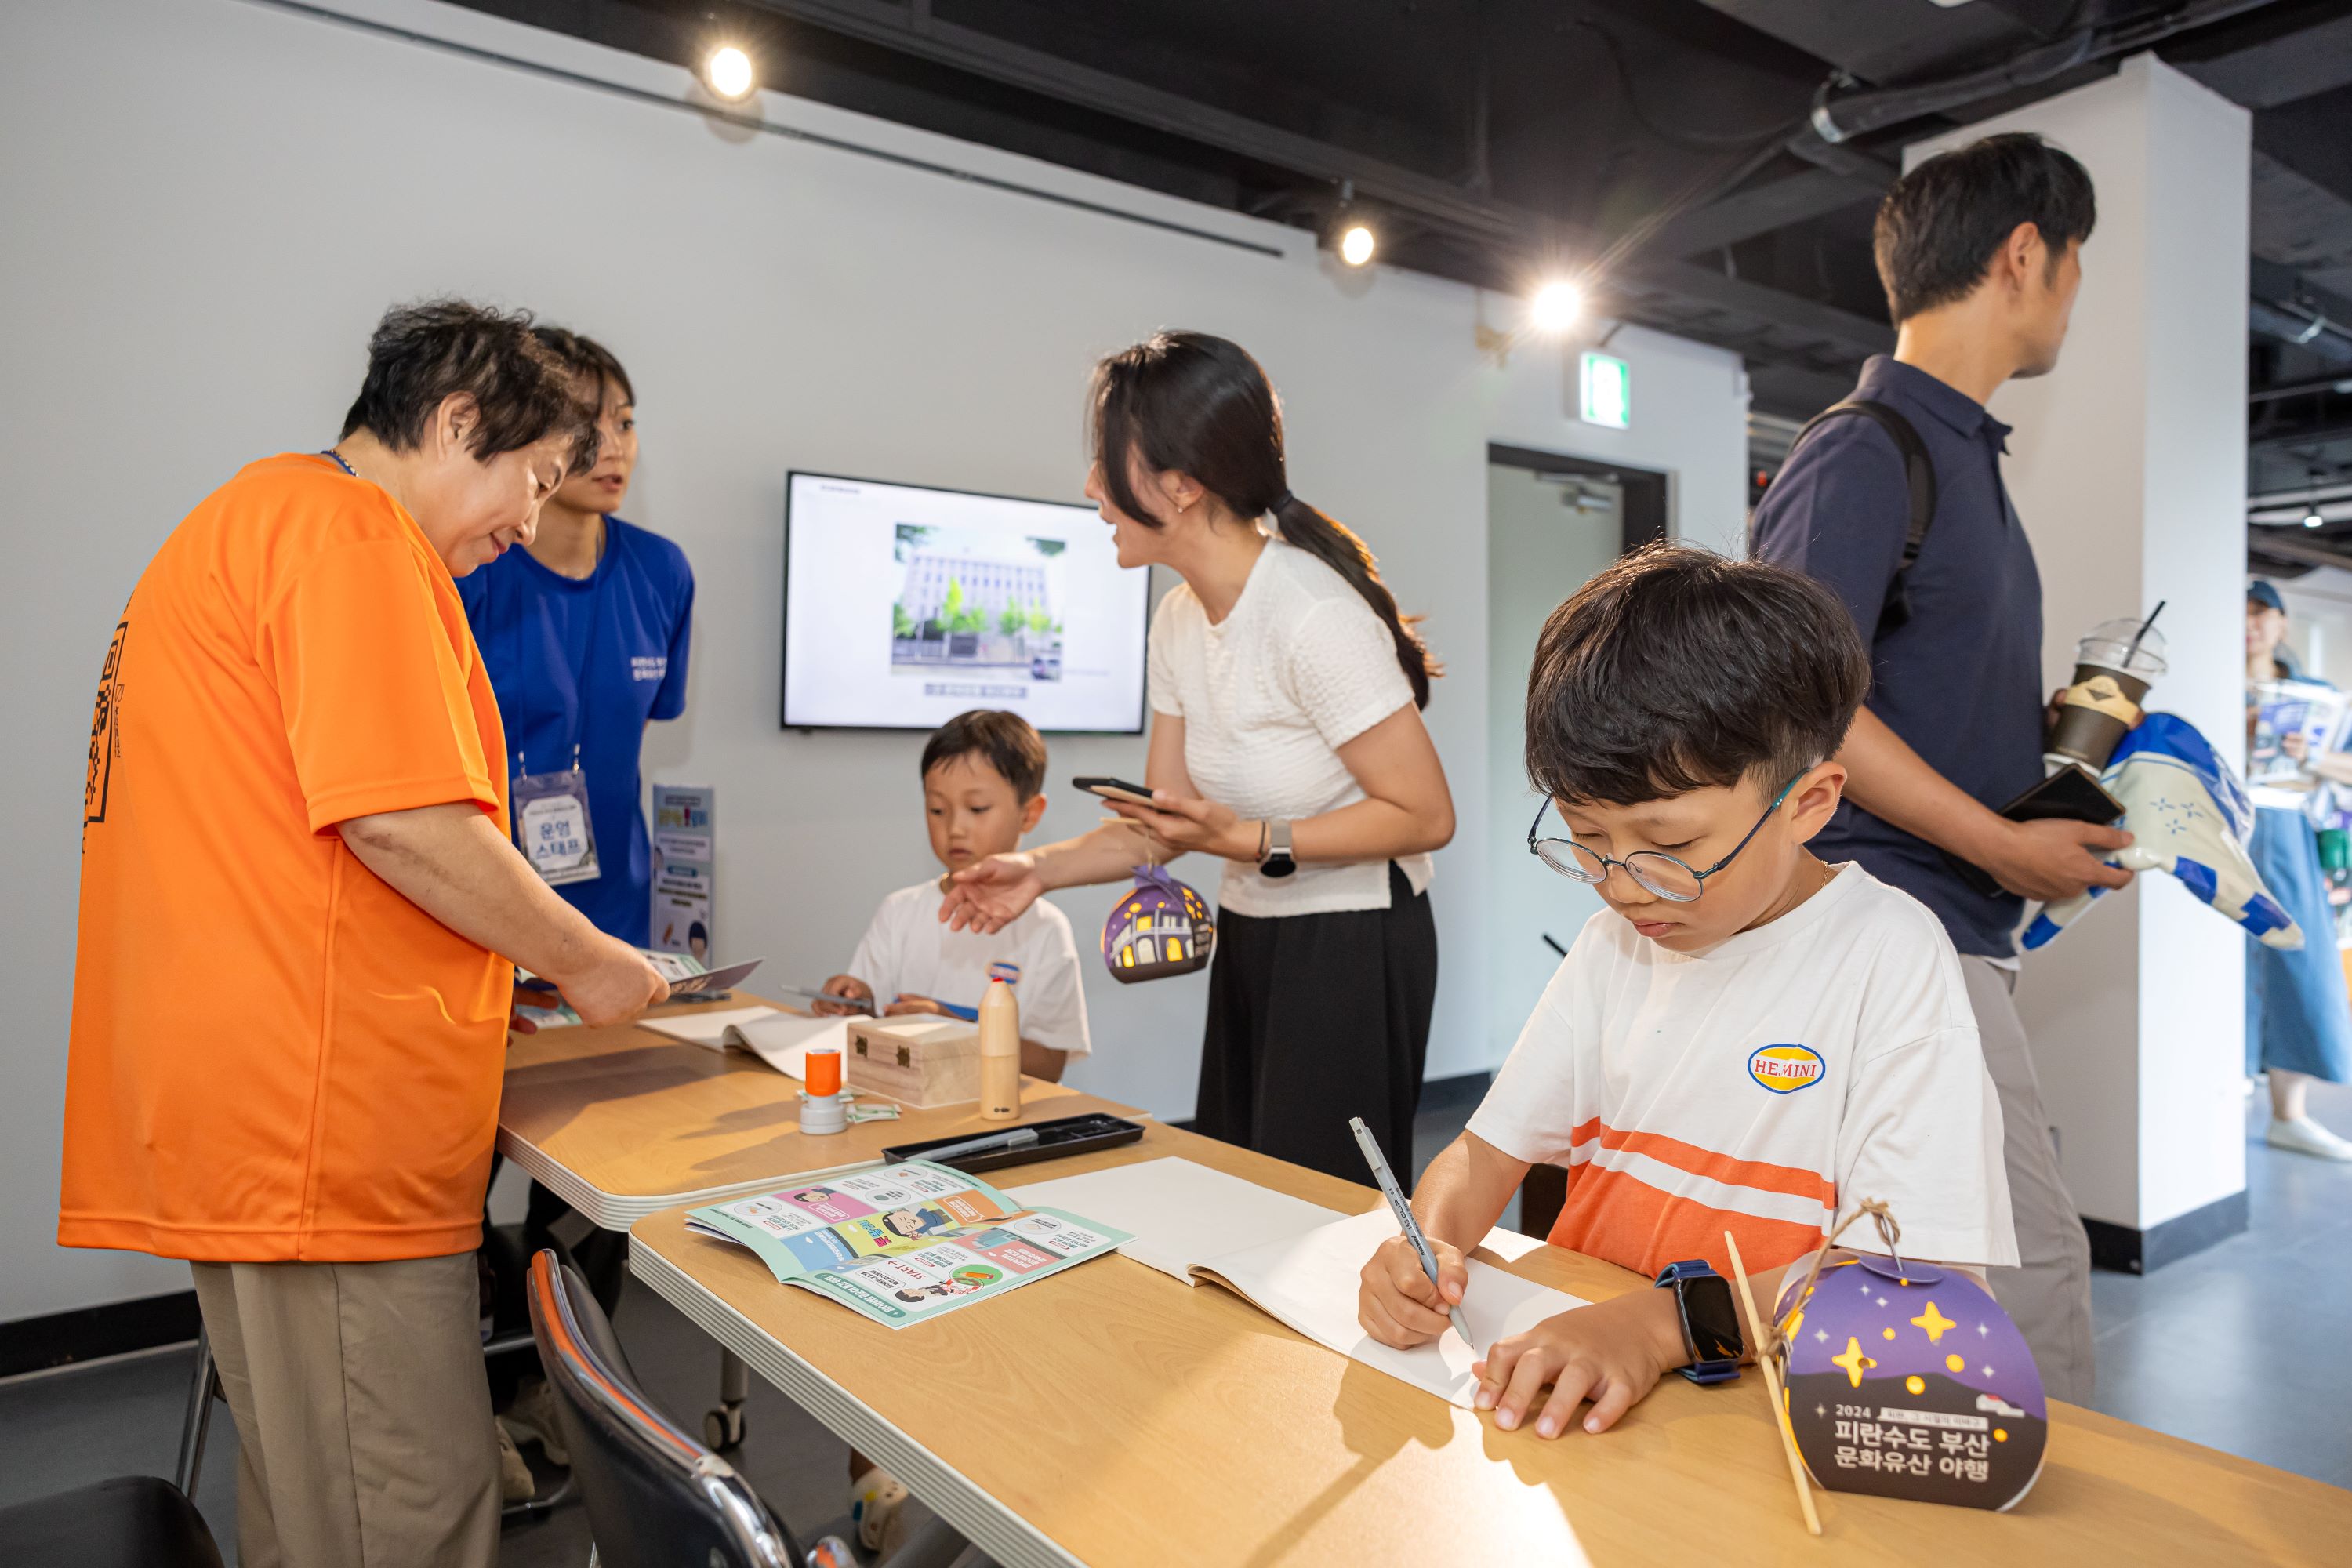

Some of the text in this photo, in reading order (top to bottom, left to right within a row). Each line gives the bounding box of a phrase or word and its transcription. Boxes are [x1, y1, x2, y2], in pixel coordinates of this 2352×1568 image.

[539, 820, 571, 840] 운영
[536, 838, 581, 859] 스태프
[1395, 1200, 1406, 1218] CLIP
[1411, 1235, 1425, 1255] monami
[897, 1265, 926, 1280] START
[1835, 1403, 1871, 1419] 2024
[1835, 1421, 1991, 1458] 피란수도 부산
[1834, 1446, 1989, 1483] 문화유산 야행
